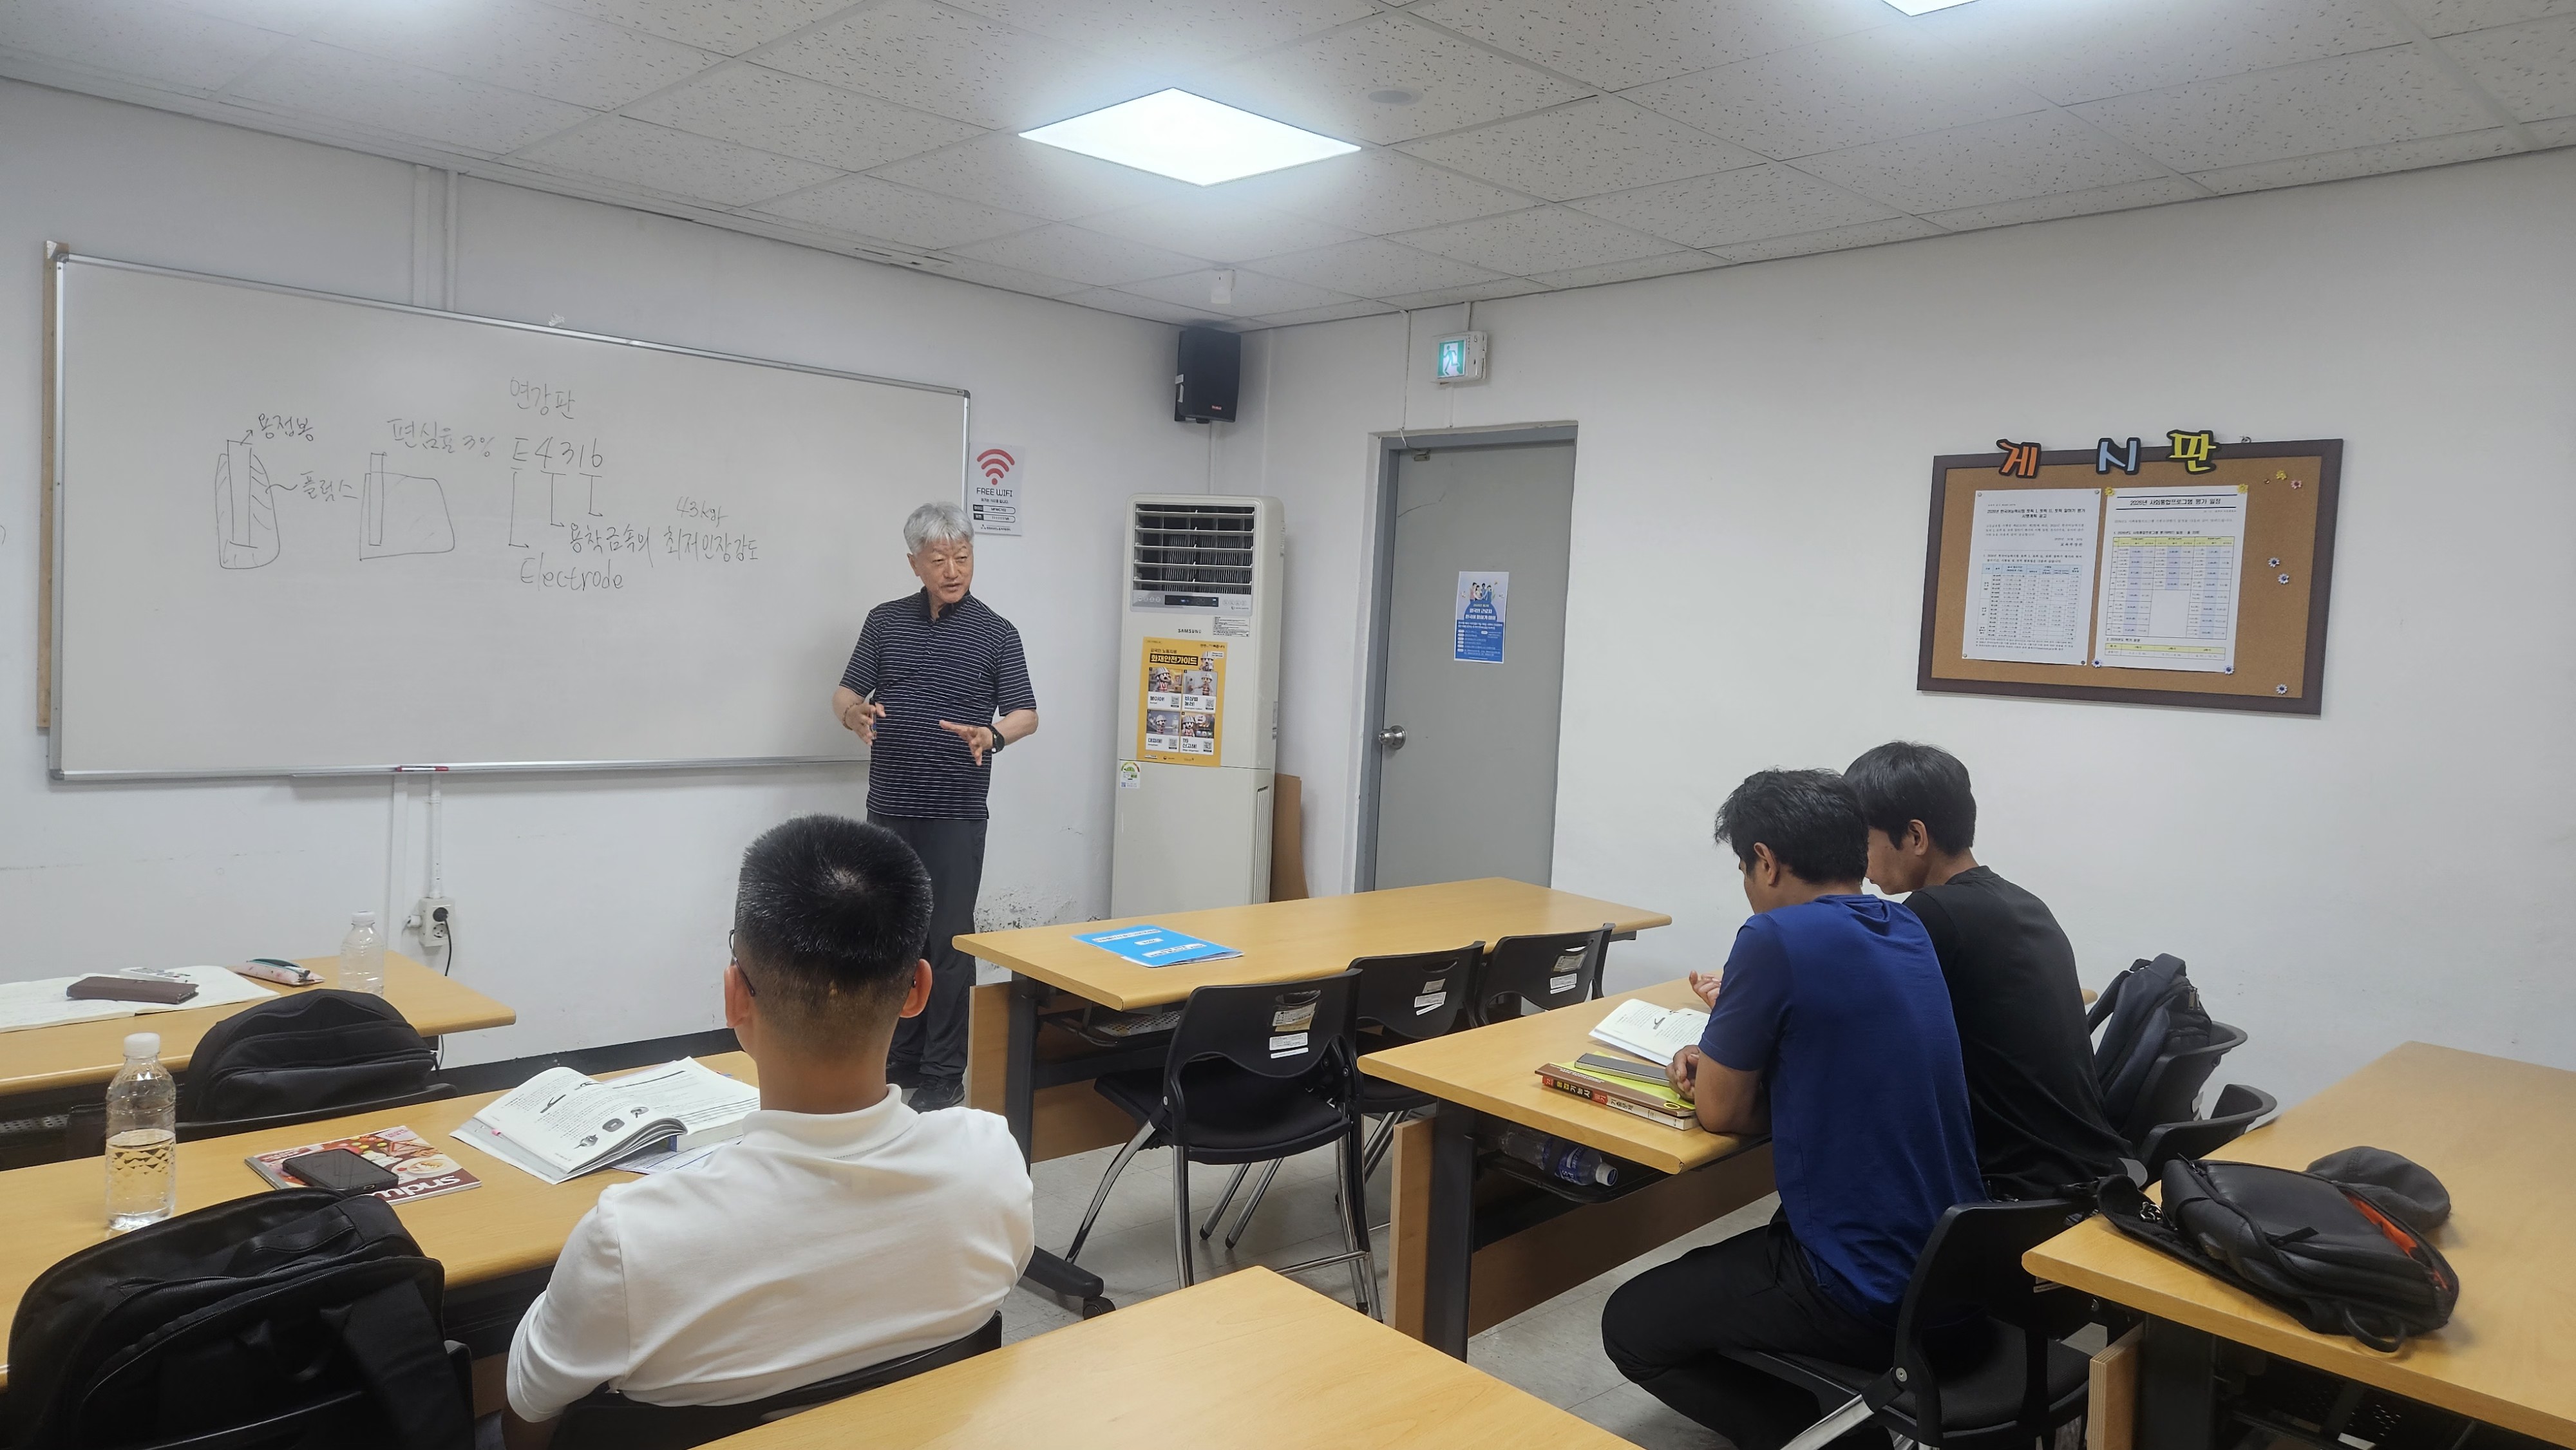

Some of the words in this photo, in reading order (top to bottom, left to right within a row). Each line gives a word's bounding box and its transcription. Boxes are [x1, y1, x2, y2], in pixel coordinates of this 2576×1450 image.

[510, 377, 576, 419] 연강판
[976, 487, 994, 496] FREE
[996, 489, 1012, 497] WIFI
[520, 552, 624, 591] Electrode
[1151, 654, 1197, 664] 화재안전가이드
[362, 1175, 461, 1198] mpus
